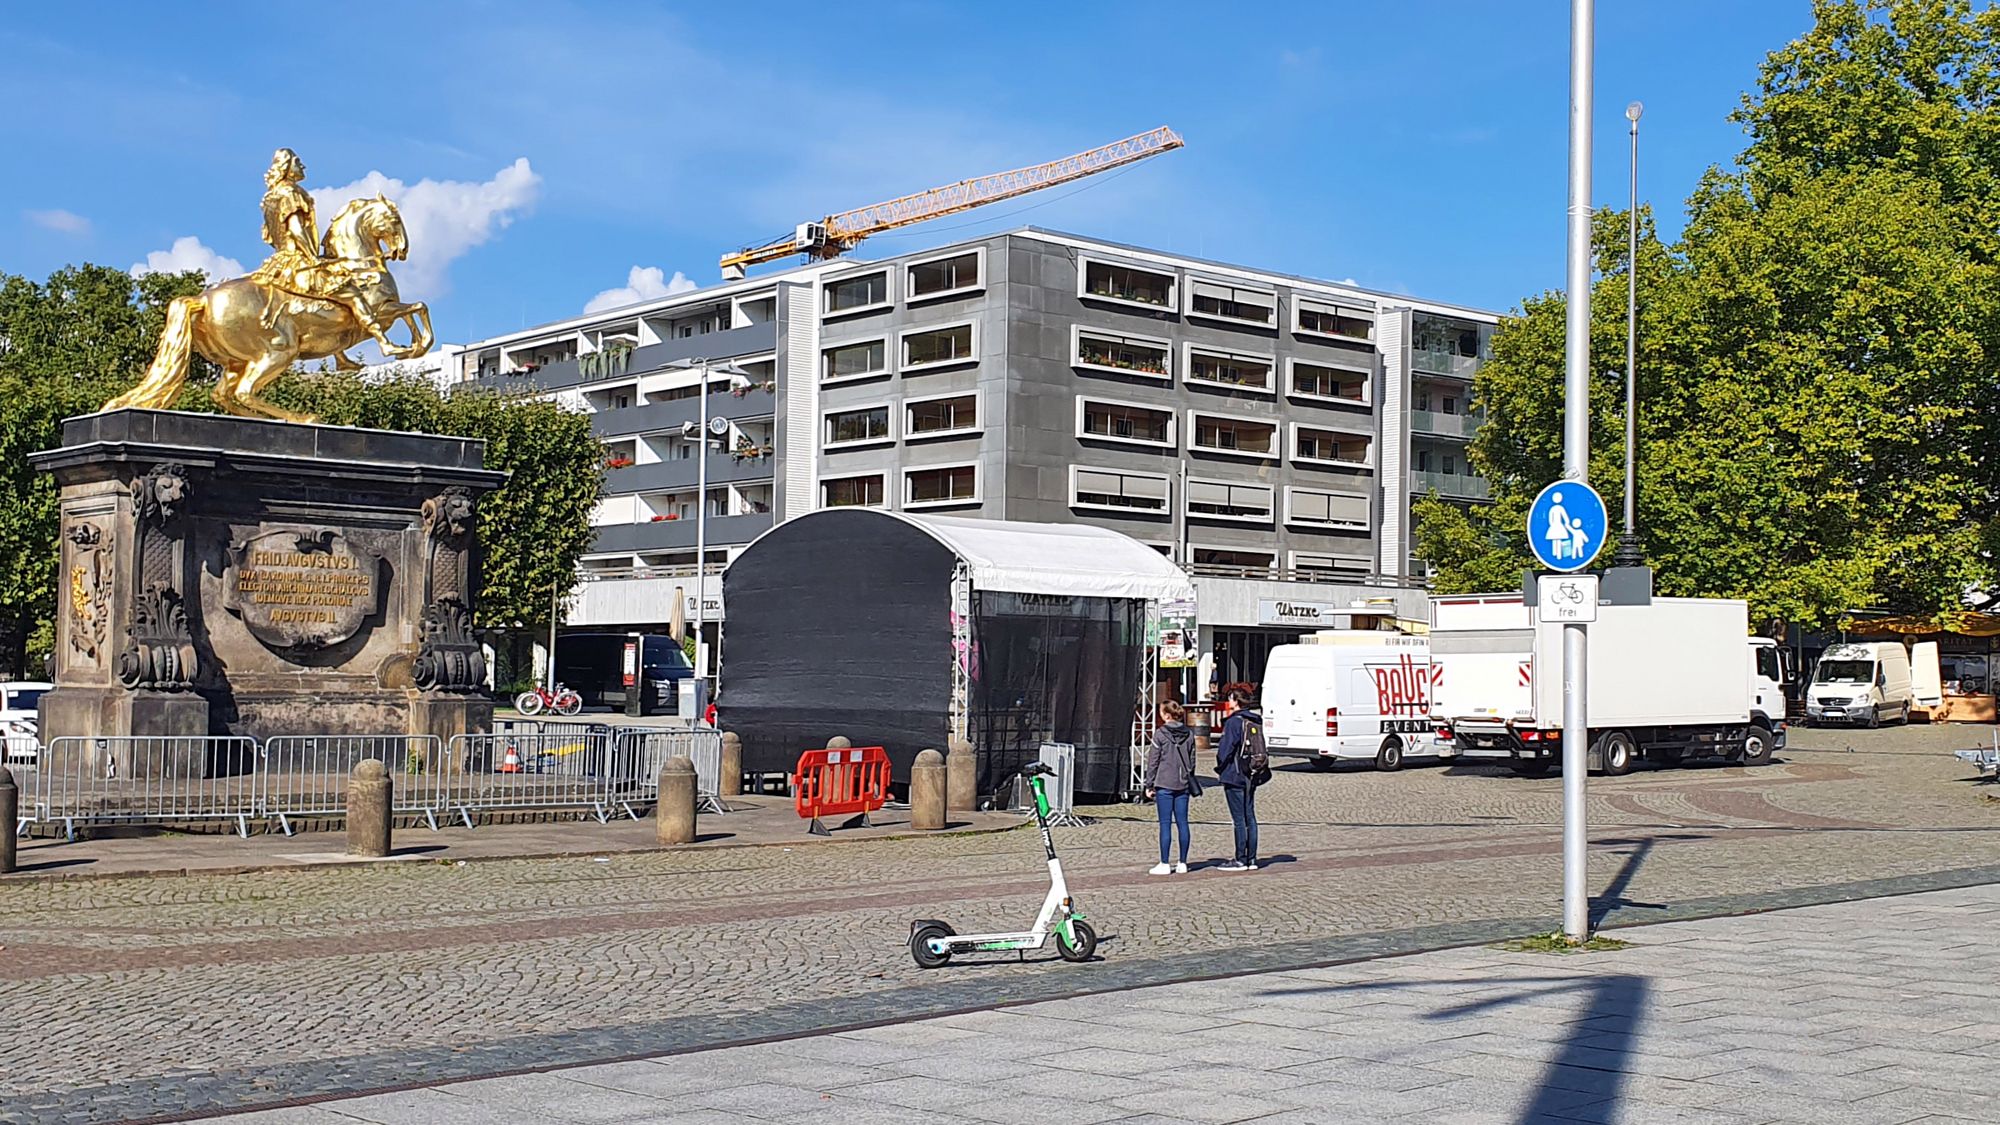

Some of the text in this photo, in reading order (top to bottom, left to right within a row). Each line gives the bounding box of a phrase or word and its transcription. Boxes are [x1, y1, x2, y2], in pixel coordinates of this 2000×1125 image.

[253, 552, 284, 566] FRID.
[285, 553, 349, 569] AVGVSTVS
[240, 582, 276, 592] ELECTOR
[270, 609, 326, 623] AVGVSTVS
[1559, 608, 1577, 617] frei
[1383, 721, 1432, 733] EVENT
